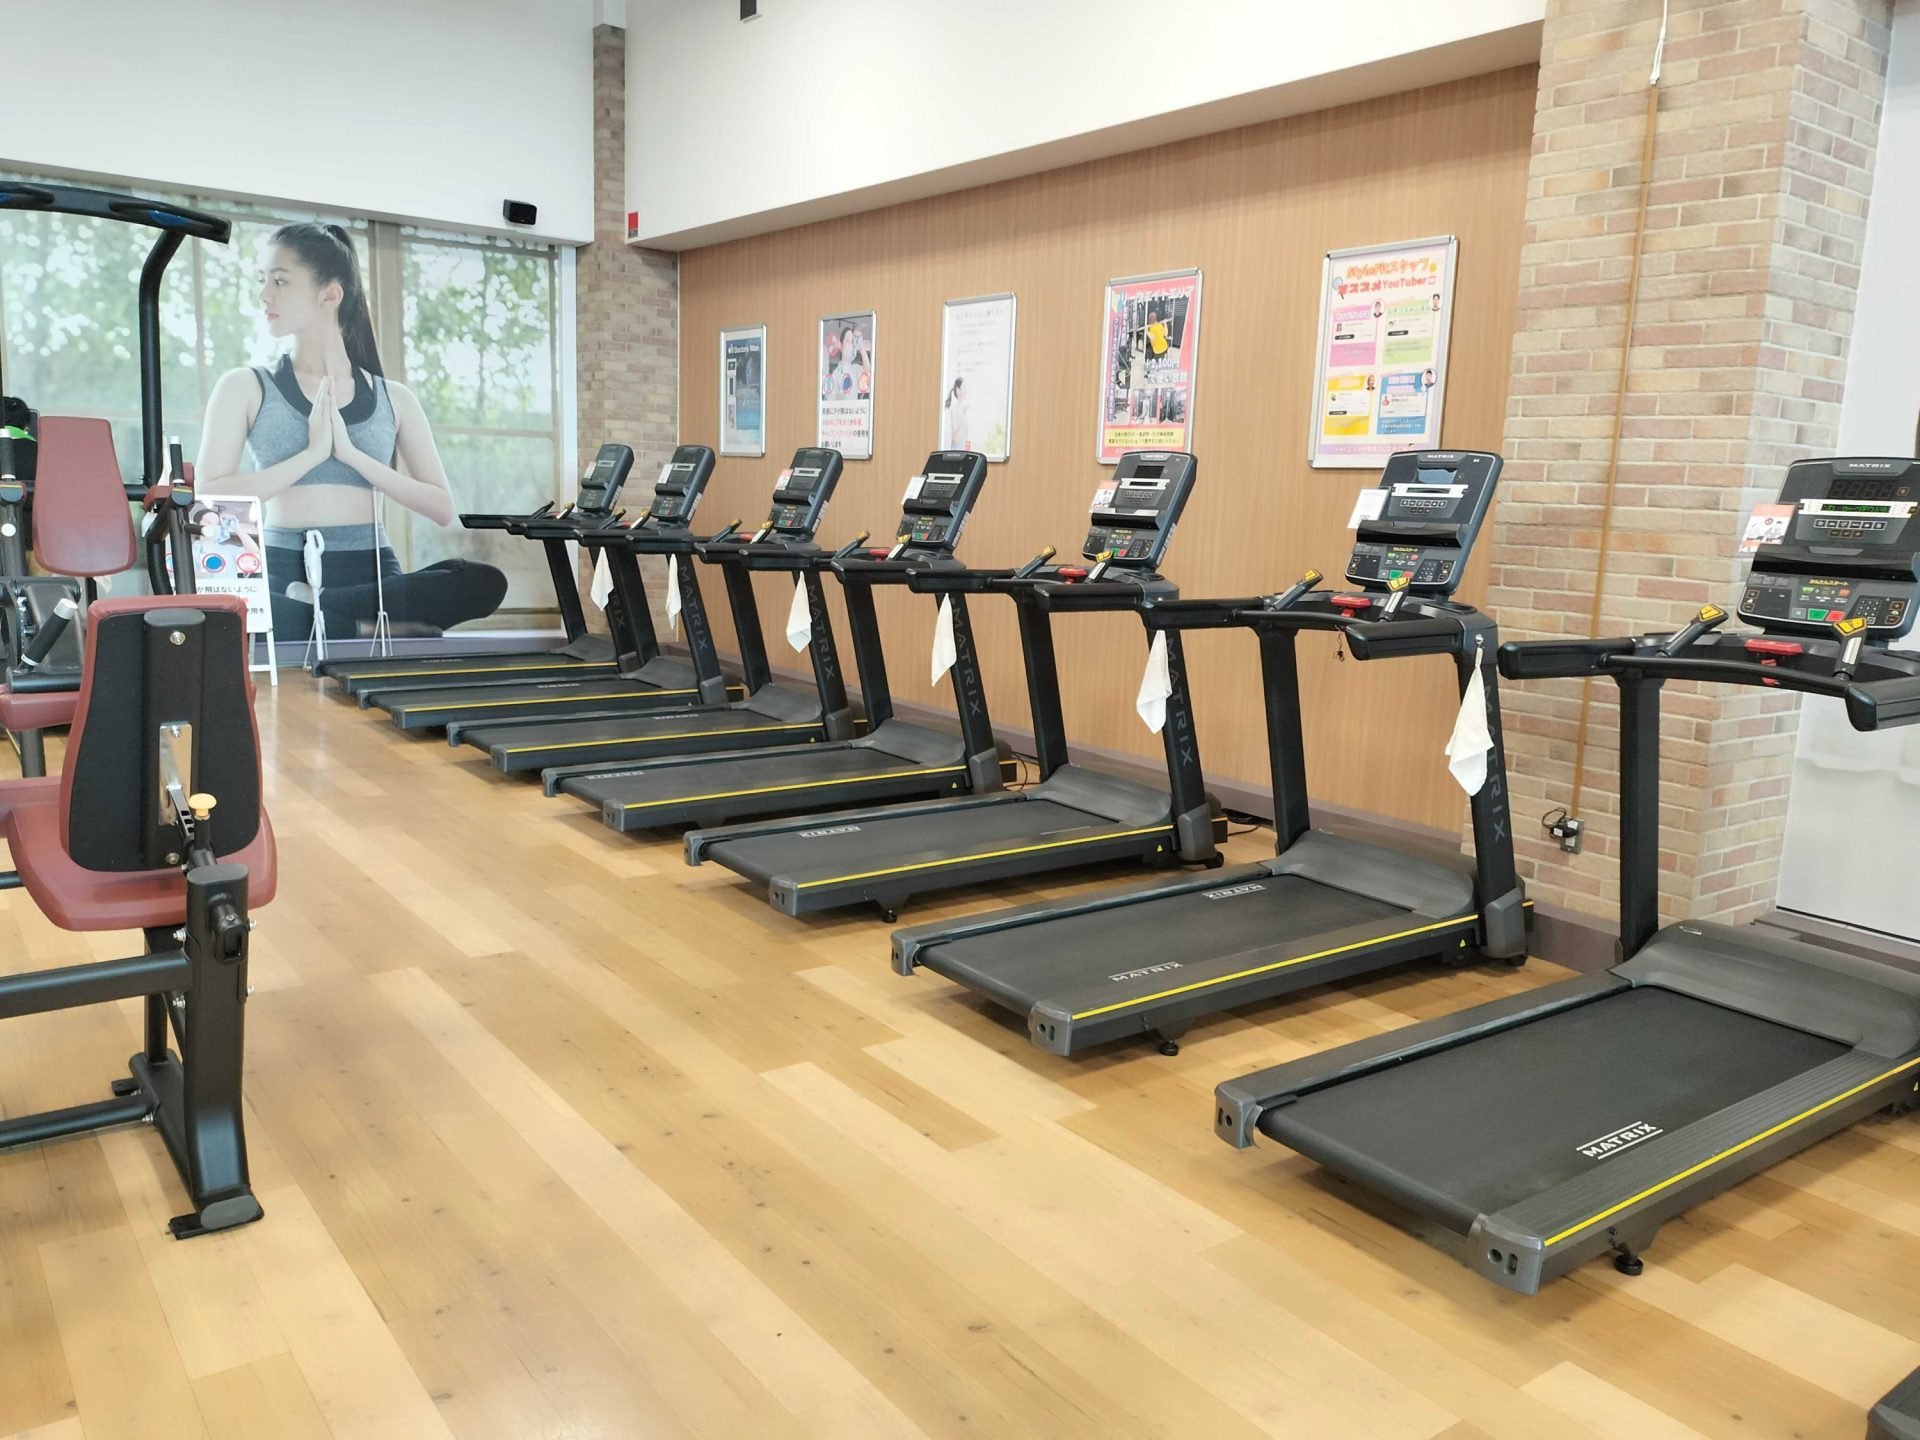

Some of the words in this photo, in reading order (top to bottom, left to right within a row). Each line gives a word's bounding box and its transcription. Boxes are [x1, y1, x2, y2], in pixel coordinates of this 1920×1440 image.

[679, 565, 709, 650] MATRIX
[808, 585, 835, 681] MATRIX
[953, 607, 981, 717] MATRIX
[1111, 962, 1184, 982] MATRIX
[1581, 1123, 1657, 1157] MATRIX
